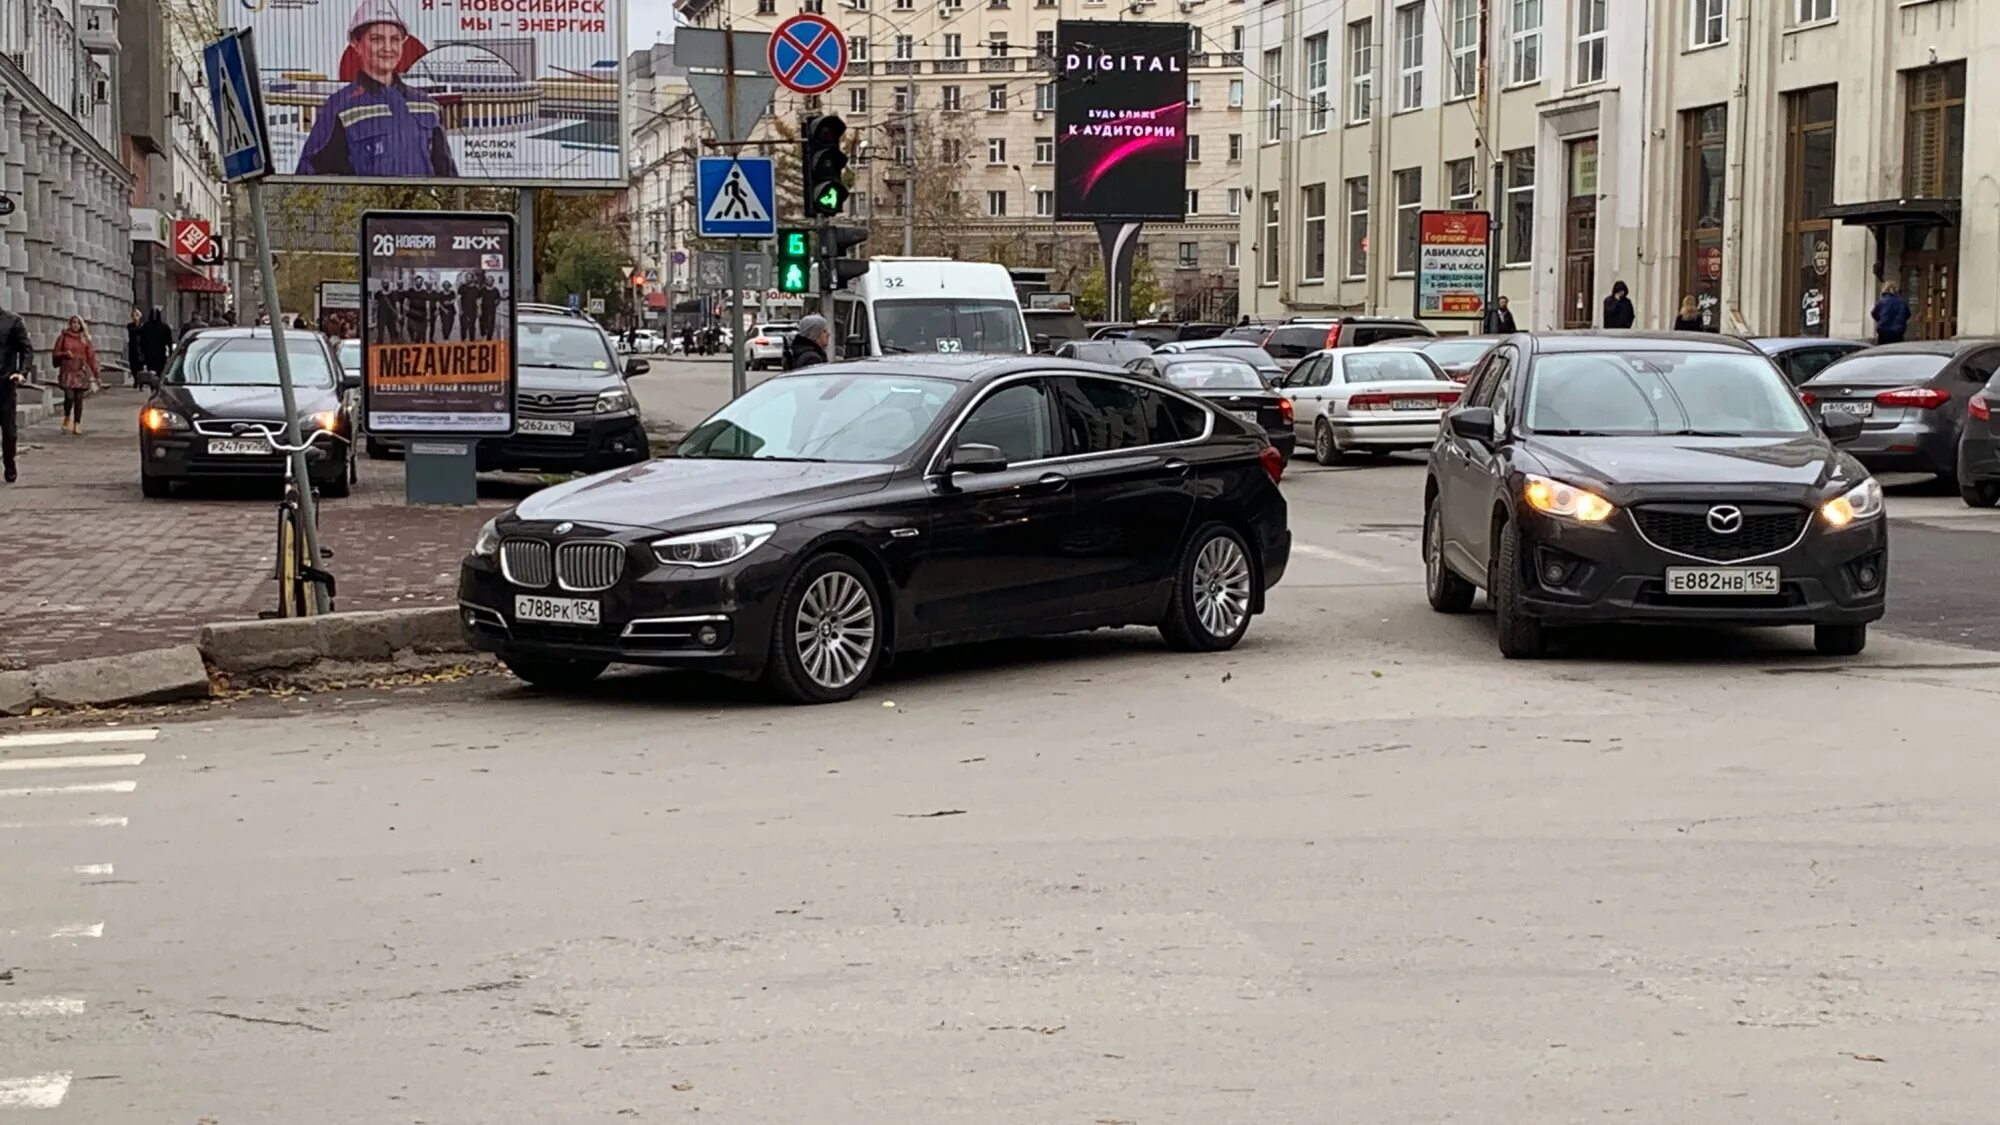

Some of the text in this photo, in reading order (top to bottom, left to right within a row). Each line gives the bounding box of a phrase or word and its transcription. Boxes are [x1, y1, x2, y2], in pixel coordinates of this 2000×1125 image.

[422, 0, 434, 10] Я
[460, 0, 605, 13] НОВОСИБИРСК
[461, 18, 492, 31] МЫ
[518, 19, 605, 32] ЭНЕРГИЯ
[1066, 54, 1180, 72] DIGITAL
[1089, 109, 1156, 120] БУДЬ БЛИЖЕ
[1069, 125, 1175, 137] К АУДИТОРИИ
[464, 140, 516, 149] МАСЛЮК
[464, 151, 513, 159] МАРИНА
[373, 234, 436, 256] 26 НОЯБРЯ
[1424, 249, 1485, 257] АВИАКАССА
[885, 277, 904, 288] 32
[939, 341, 960, 353] 32
[379, 343, 497, 378] MGZAVREBI
[1674, 572, 1743, 590] Е882НВ
[1747, 571, 1775, 585] 154
[519, 598, 595, 620] С788РК 154
